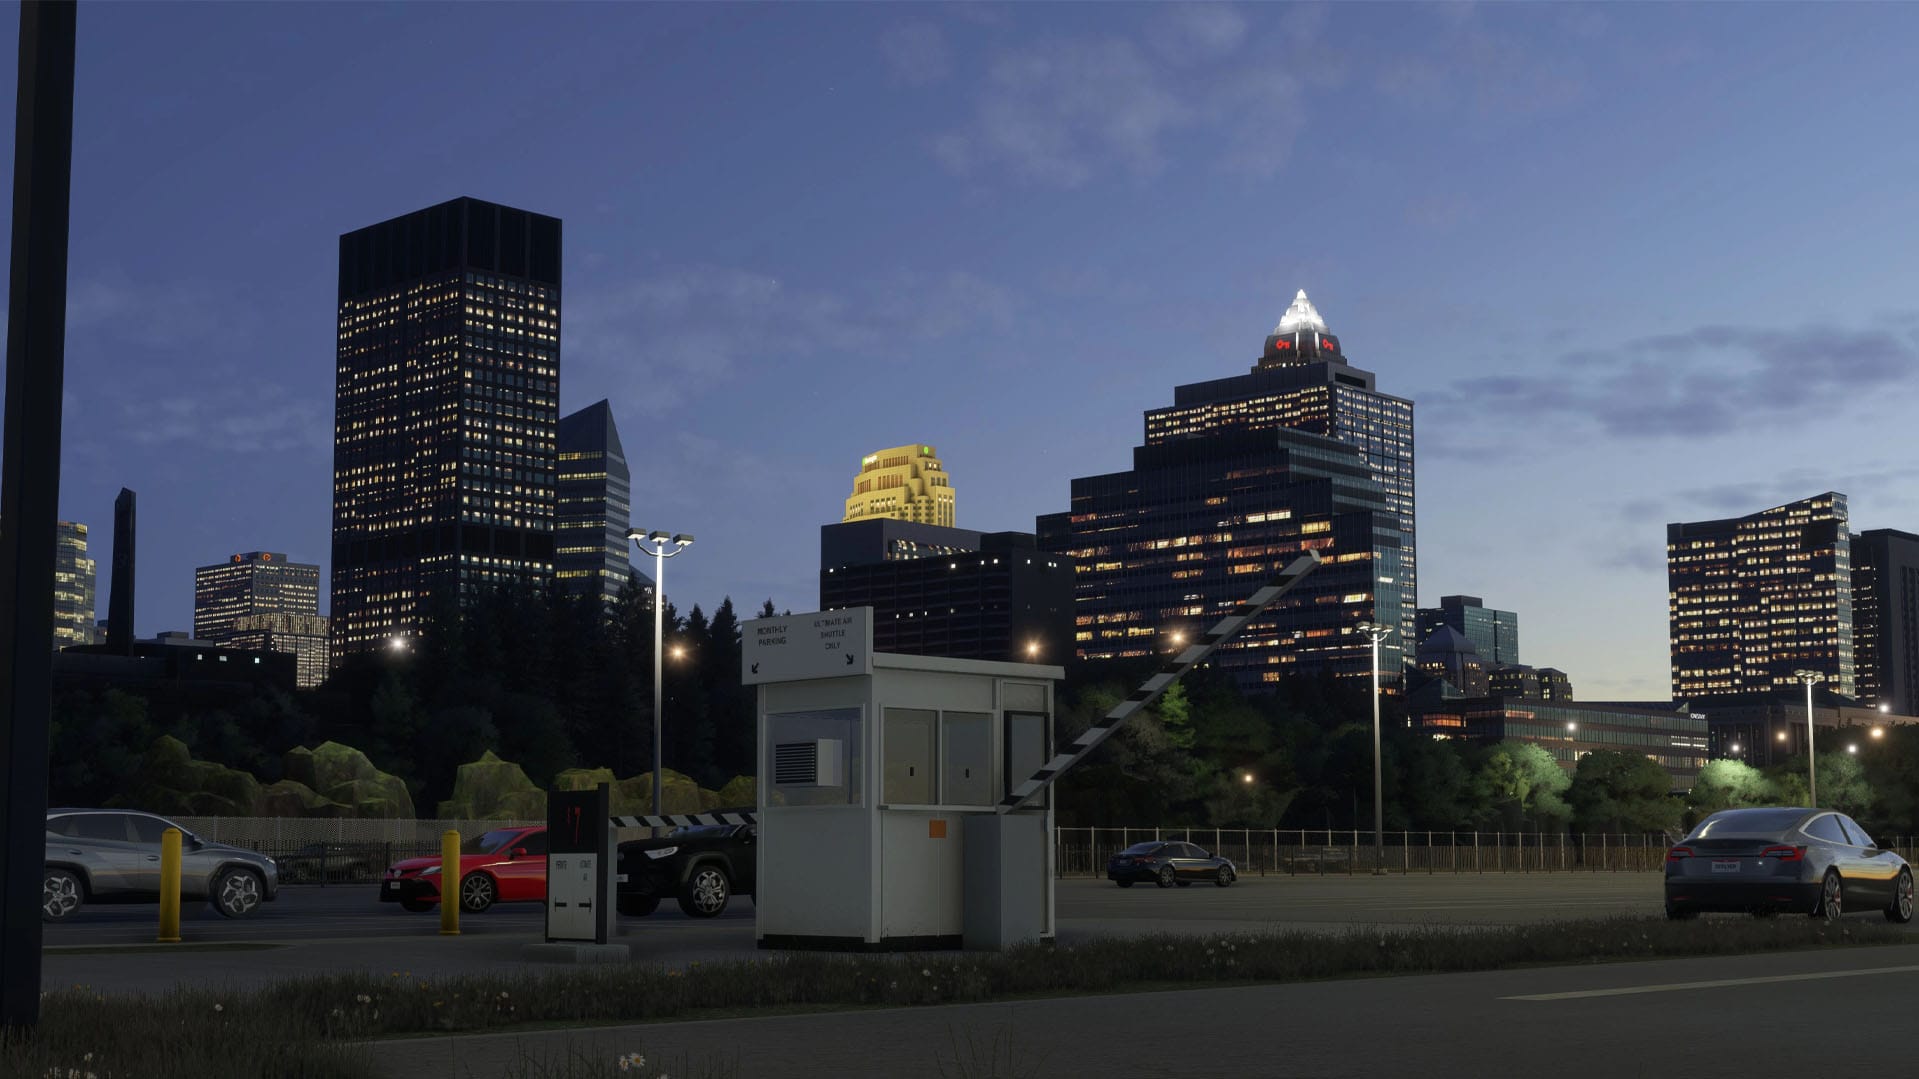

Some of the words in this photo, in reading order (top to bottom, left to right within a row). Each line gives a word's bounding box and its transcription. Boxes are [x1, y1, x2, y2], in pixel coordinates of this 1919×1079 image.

[757, 625, 788, 635] MONTHLY
[759, 637, 786, 647] PARKING
[825, 642, 841, 650] ONLY
